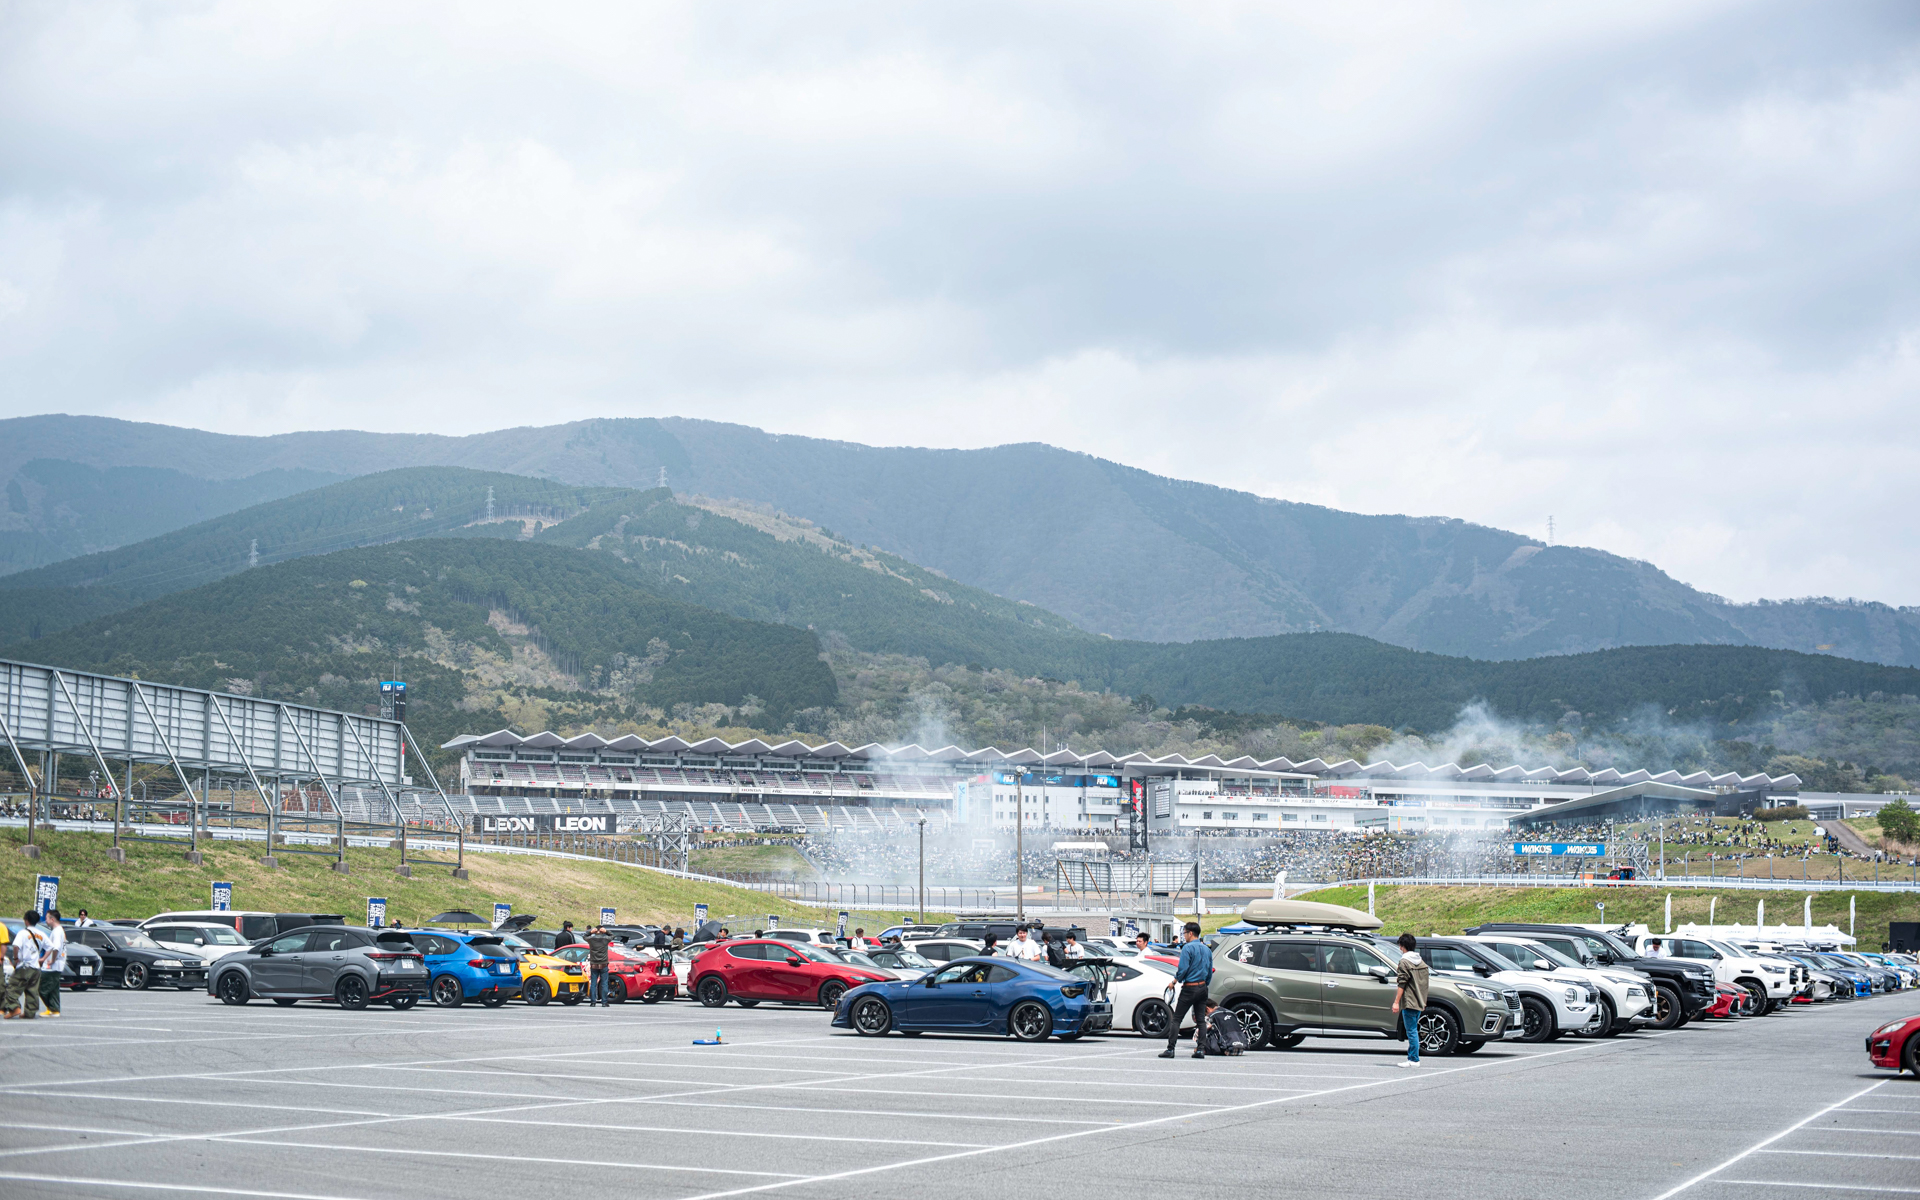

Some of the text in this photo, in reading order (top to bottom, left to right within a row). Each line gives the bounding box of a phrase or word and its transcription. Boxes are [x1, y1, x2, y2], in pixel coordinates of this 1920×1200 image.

[484, 817, 534, 831] LEON
[555, 817, 606, 831] LEON
[44, 882, 52, 898] FAN
